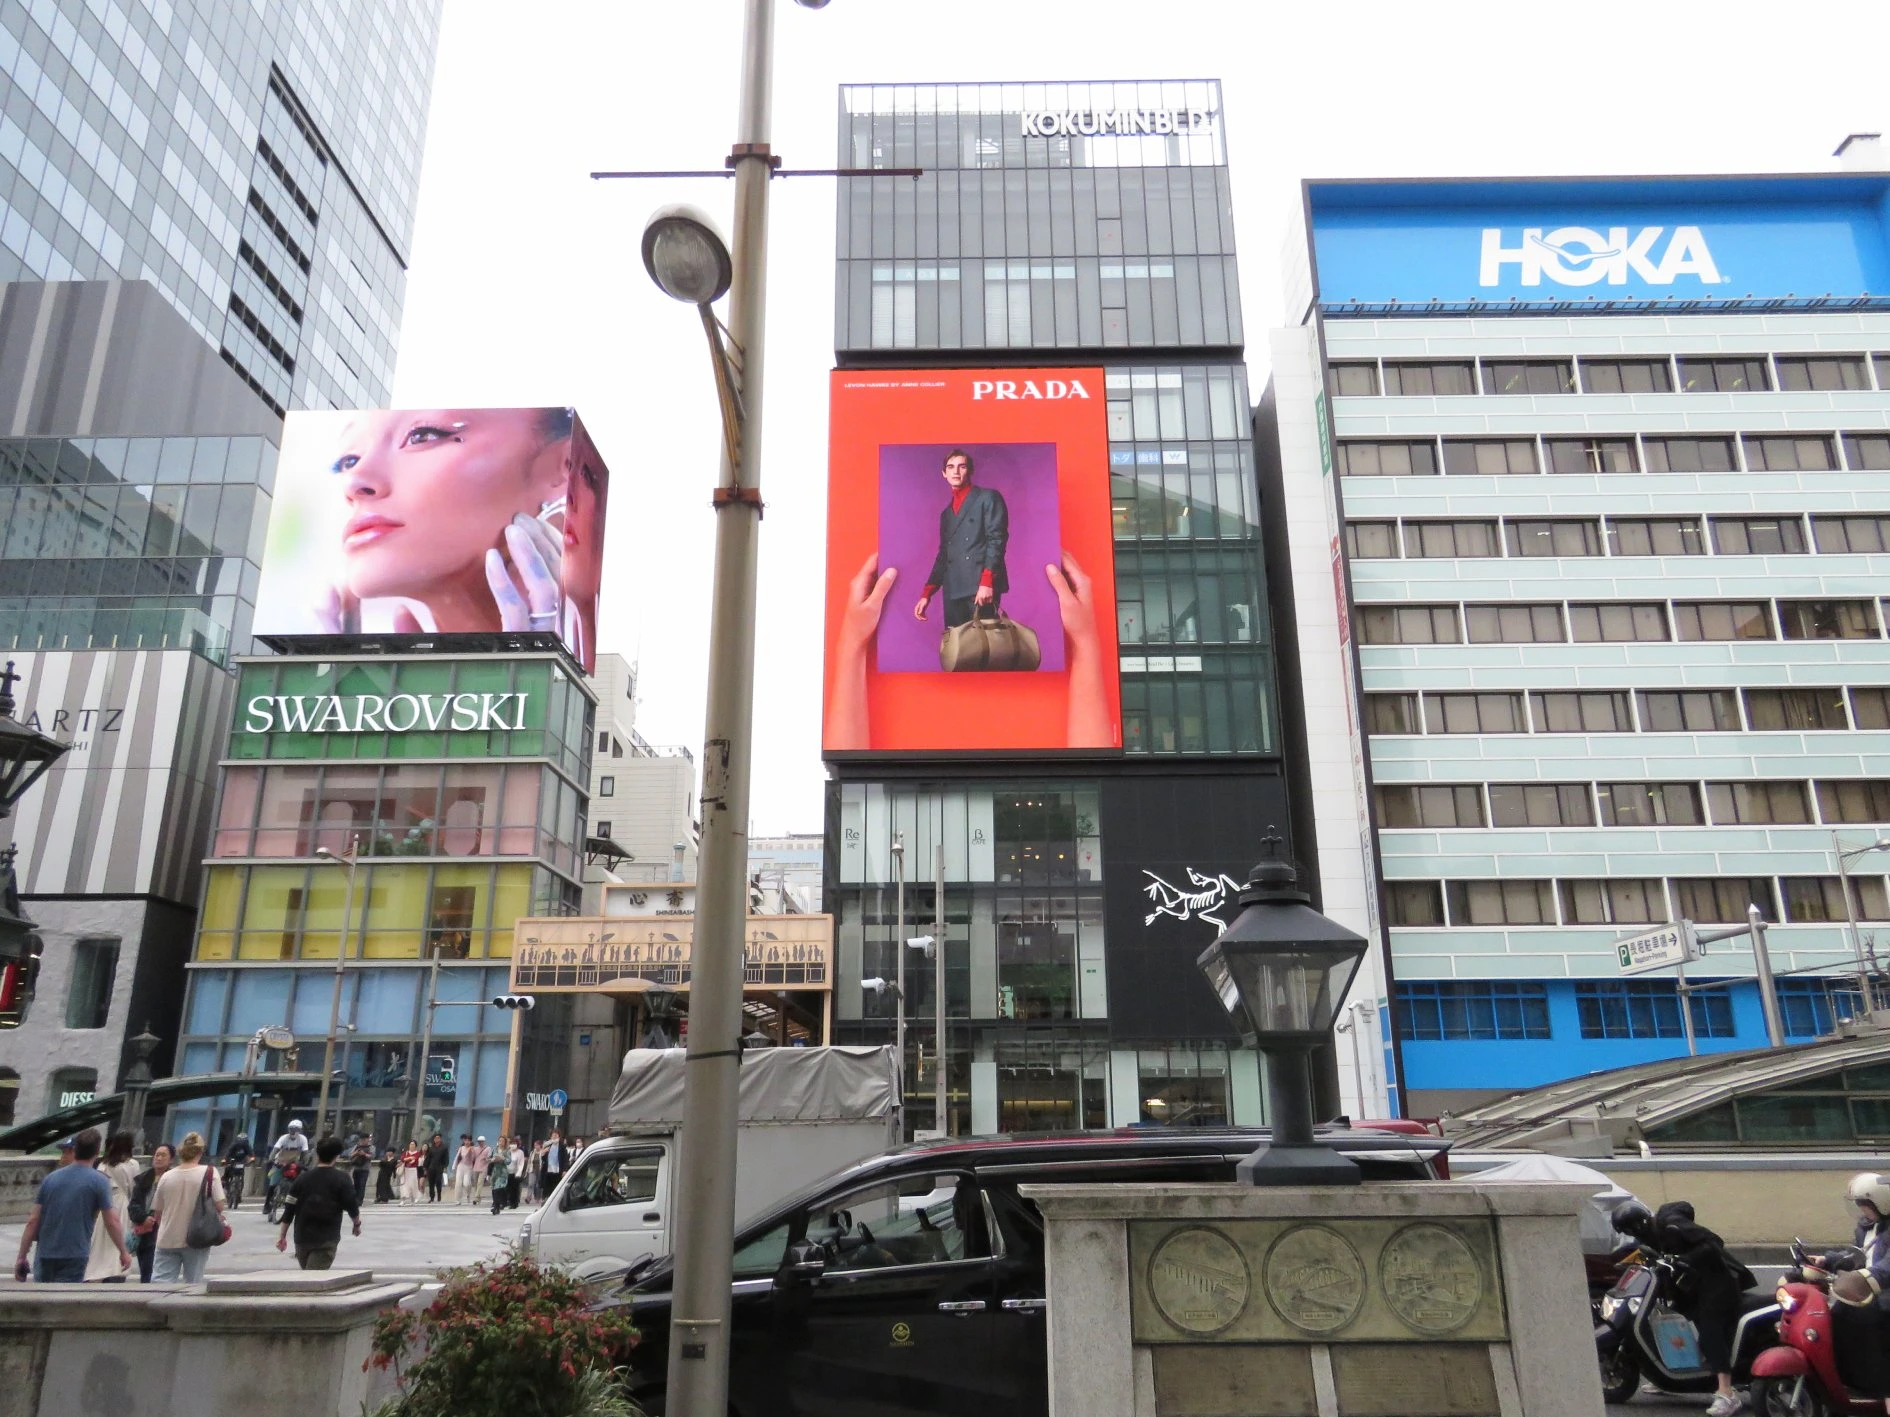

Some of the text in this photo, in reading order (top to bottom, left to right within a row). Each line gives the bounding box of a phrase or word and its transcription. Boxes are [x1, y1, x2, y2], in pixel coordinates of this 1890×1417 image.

[1020, 109, 1151, 137] KOKUMIN
[1479, 225, 1721, 286] HOKA
[972, 380, 1090, 400] PRADA
[11, 709, 124, 732] ARTZ
[245, 692, 528, 734] SWAROVSKI
[629, 889, 684, 908] 心斎
[60, 1091, 96, 1108] DIESE
[526, 1092, 550, 1111] SWARO
